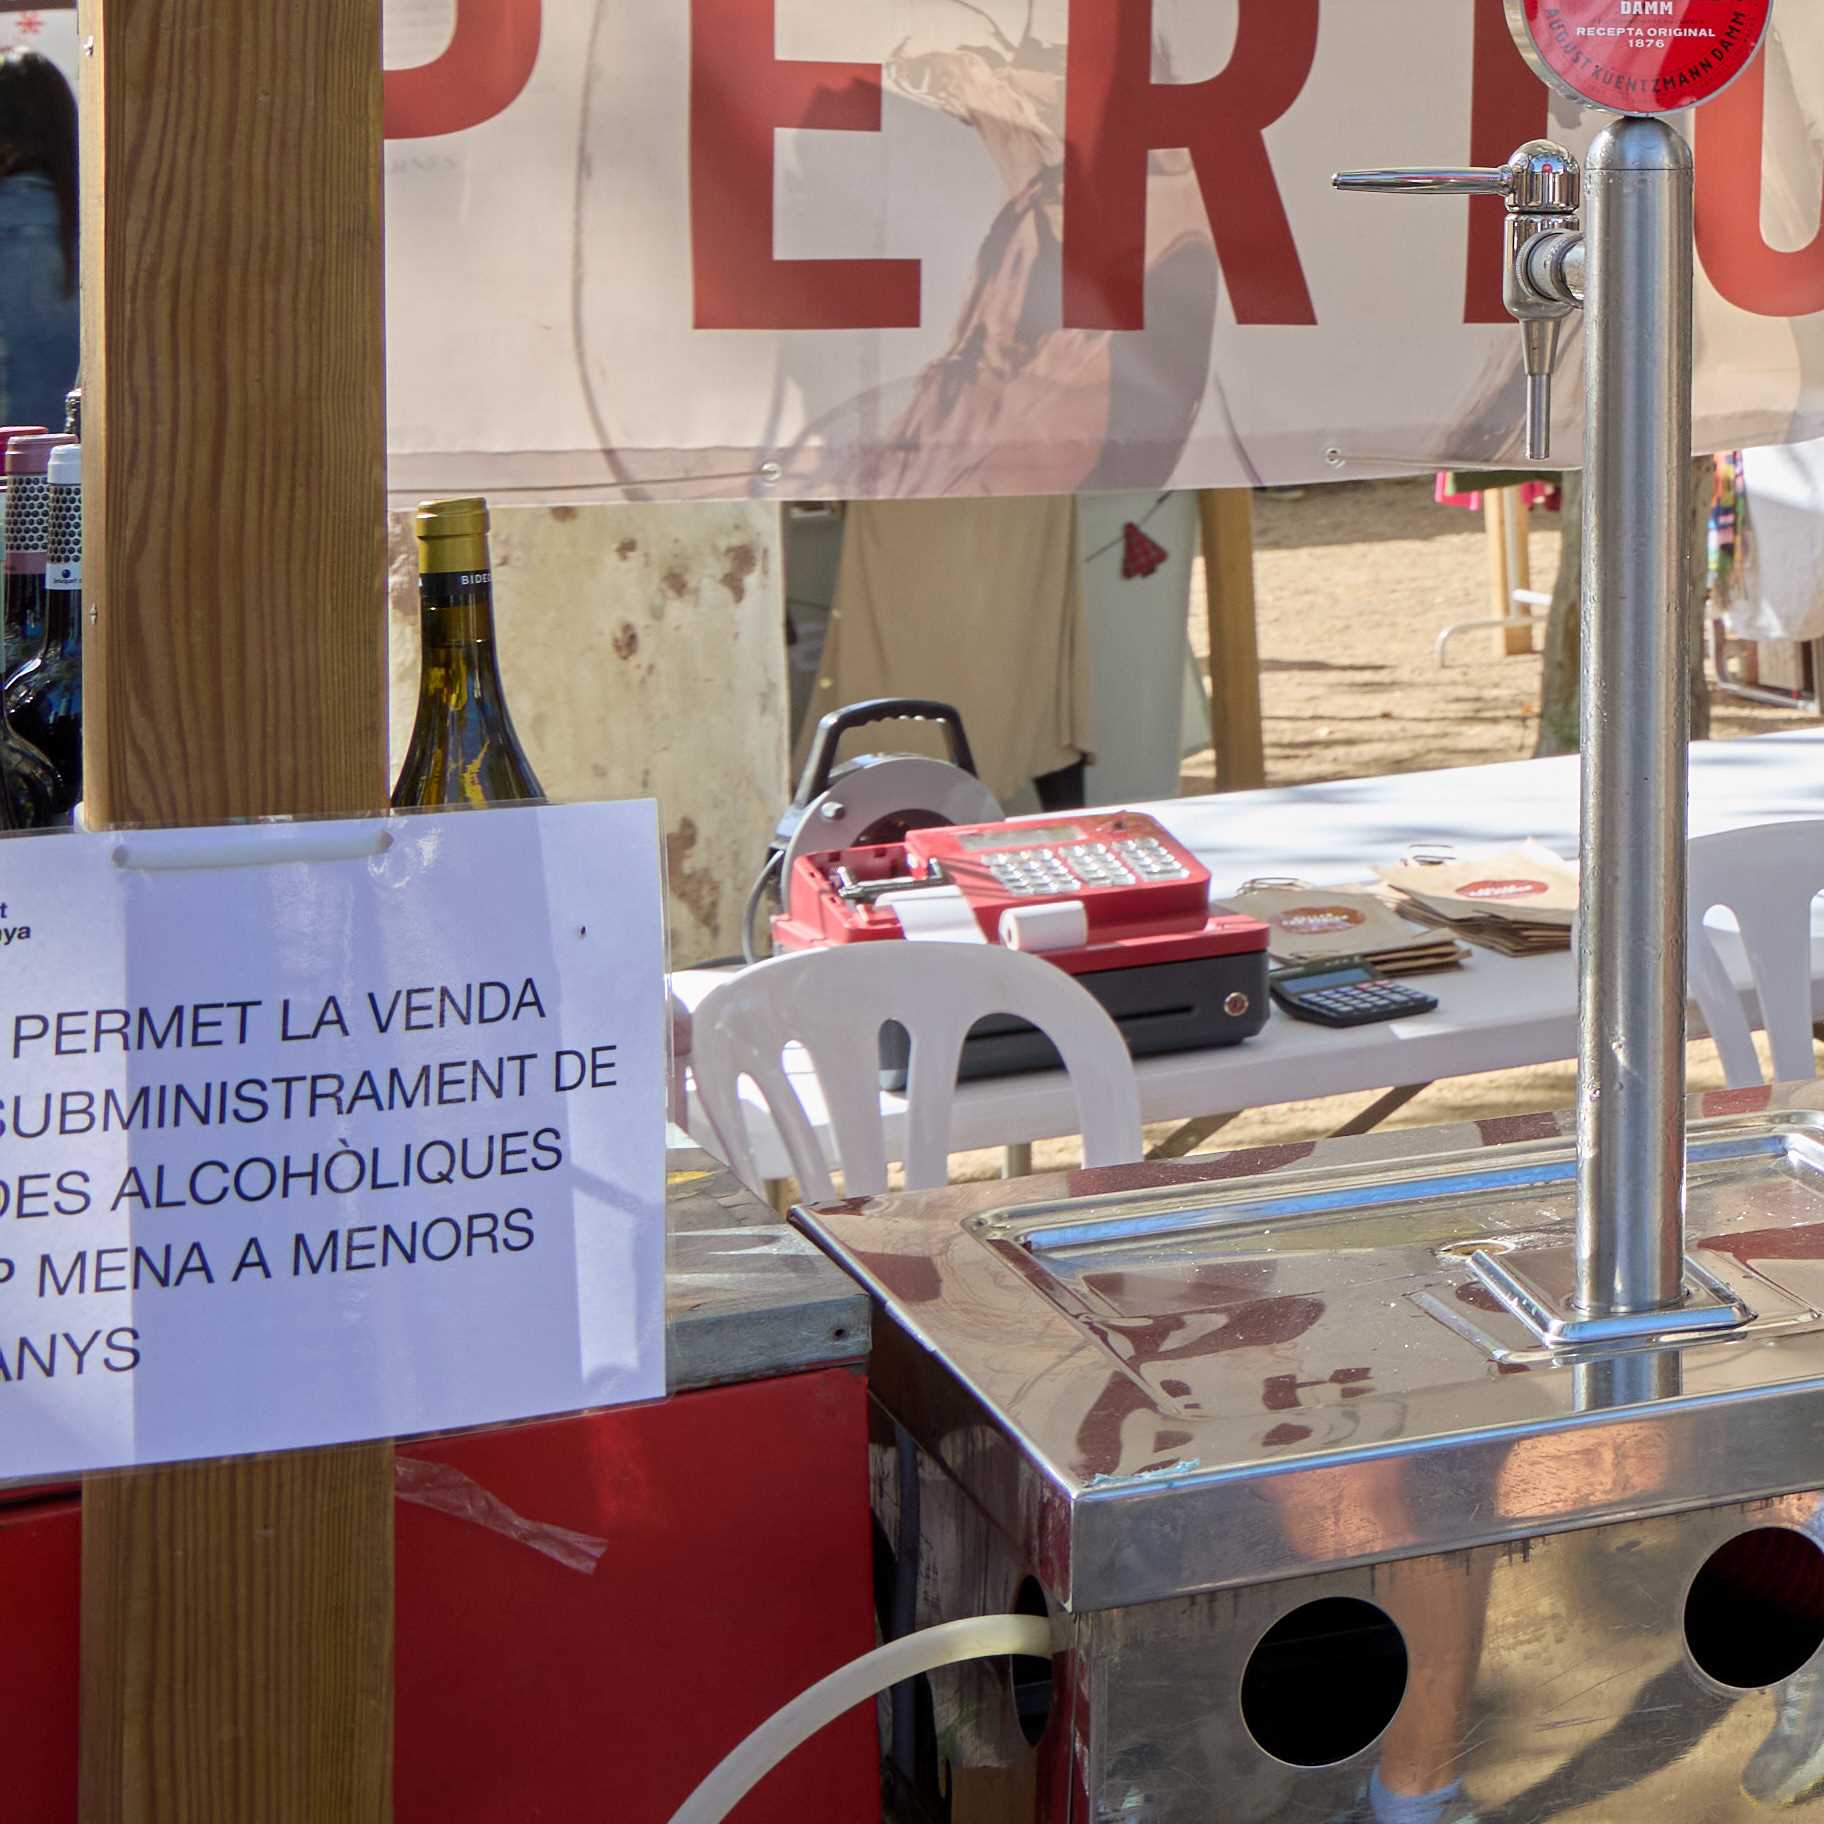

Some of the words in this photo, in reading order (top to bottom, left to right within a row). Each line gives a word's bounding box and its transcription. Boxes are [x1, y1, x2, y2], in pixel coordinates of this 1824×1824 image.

[1576, 27, 1644, 37] RECEPTA
[1647, 27, 1716, 38] ORIGINAL
[1619, 0, 1674, 16] DAMM
[1628, 39, 1665, 49] 1876
[12, 1000, 263, 1060] PERMET
[279, 995, 350, 1042] LA
[365, 976, 548, 1035] VENDA
[554, 1043, 620, 1094] DE
[111, 1128, 565, 1212] ALCOHÒLIQUES
[37, 1240, 216, 1299] MENA
[232, 1237, 274, 1282] A
[292, 1207, 537, 1279] MENORS
